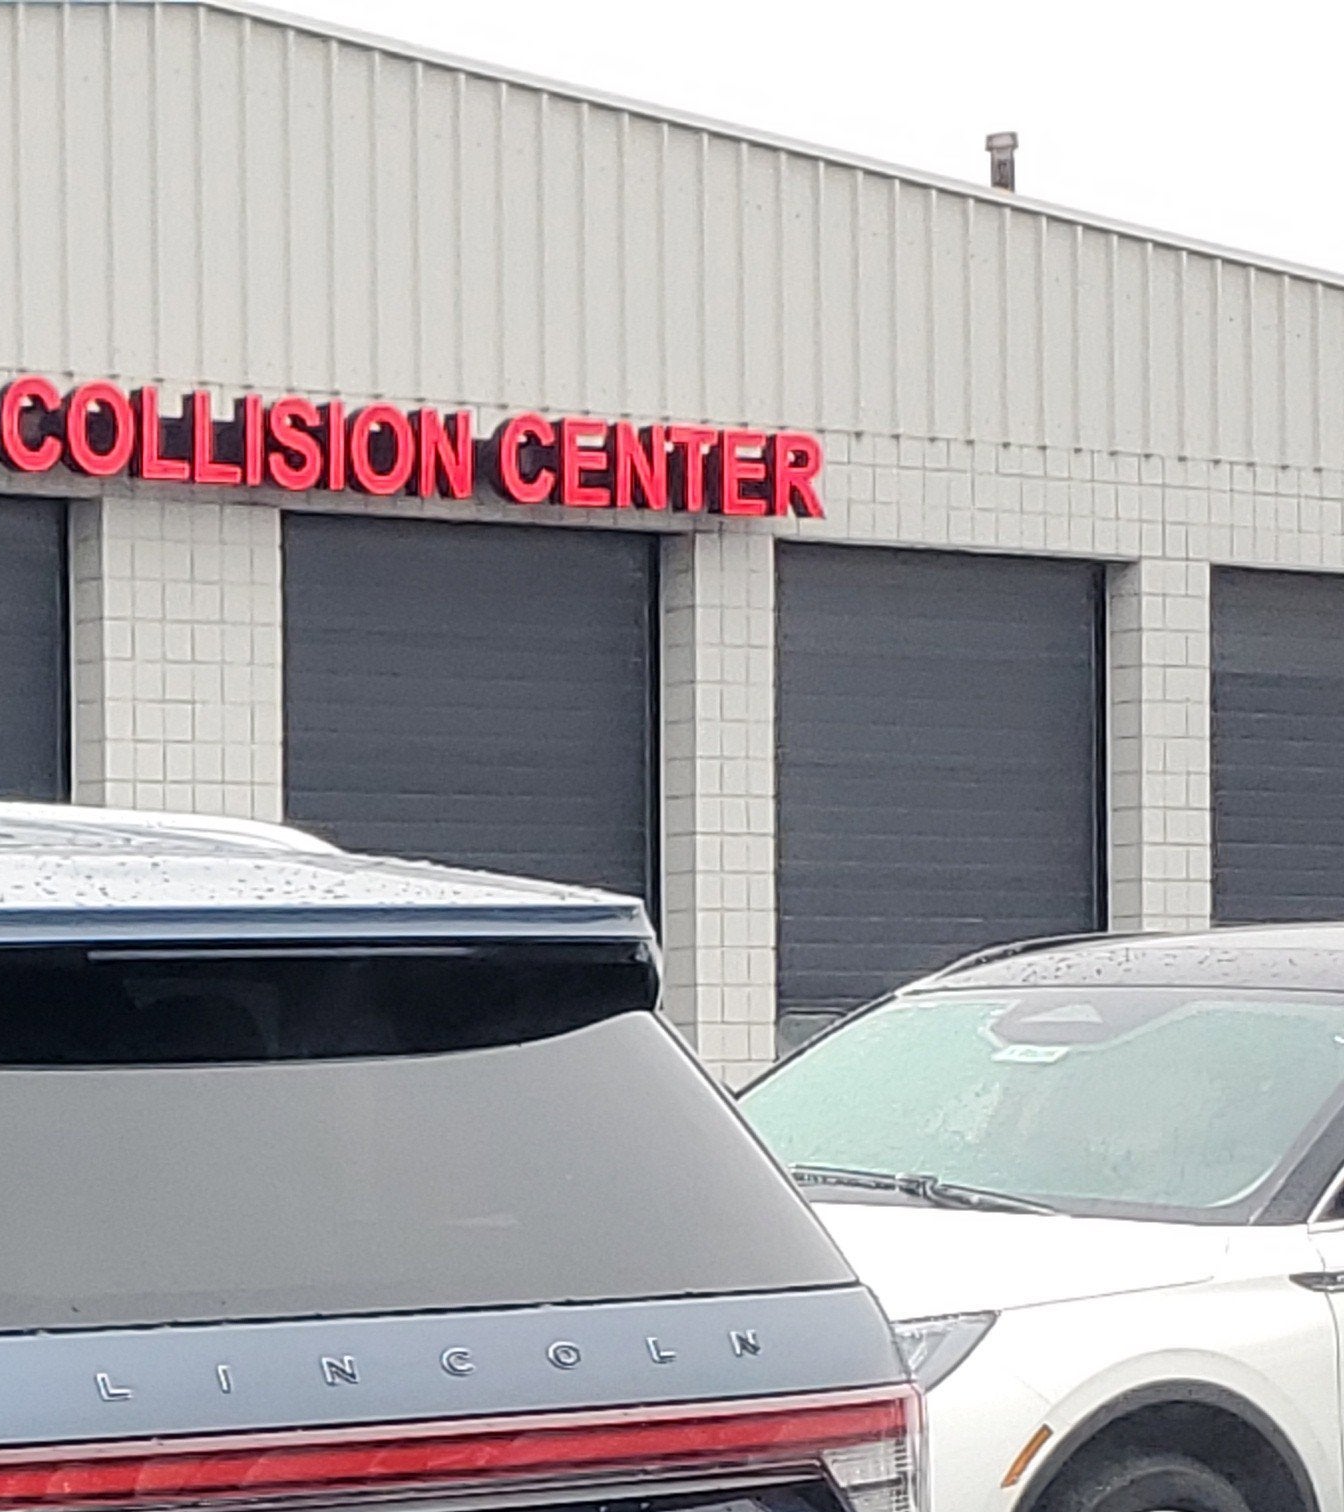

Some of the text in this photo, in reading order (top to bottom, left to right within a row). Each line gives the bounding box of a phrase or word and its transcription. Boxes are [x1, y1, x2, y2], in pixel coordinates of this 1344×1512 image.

[1, 376, 474, 500] COLLISION
[499, 412, 822, 518] CENTER
[96, 1329, 763, 1402] LINCOLN
